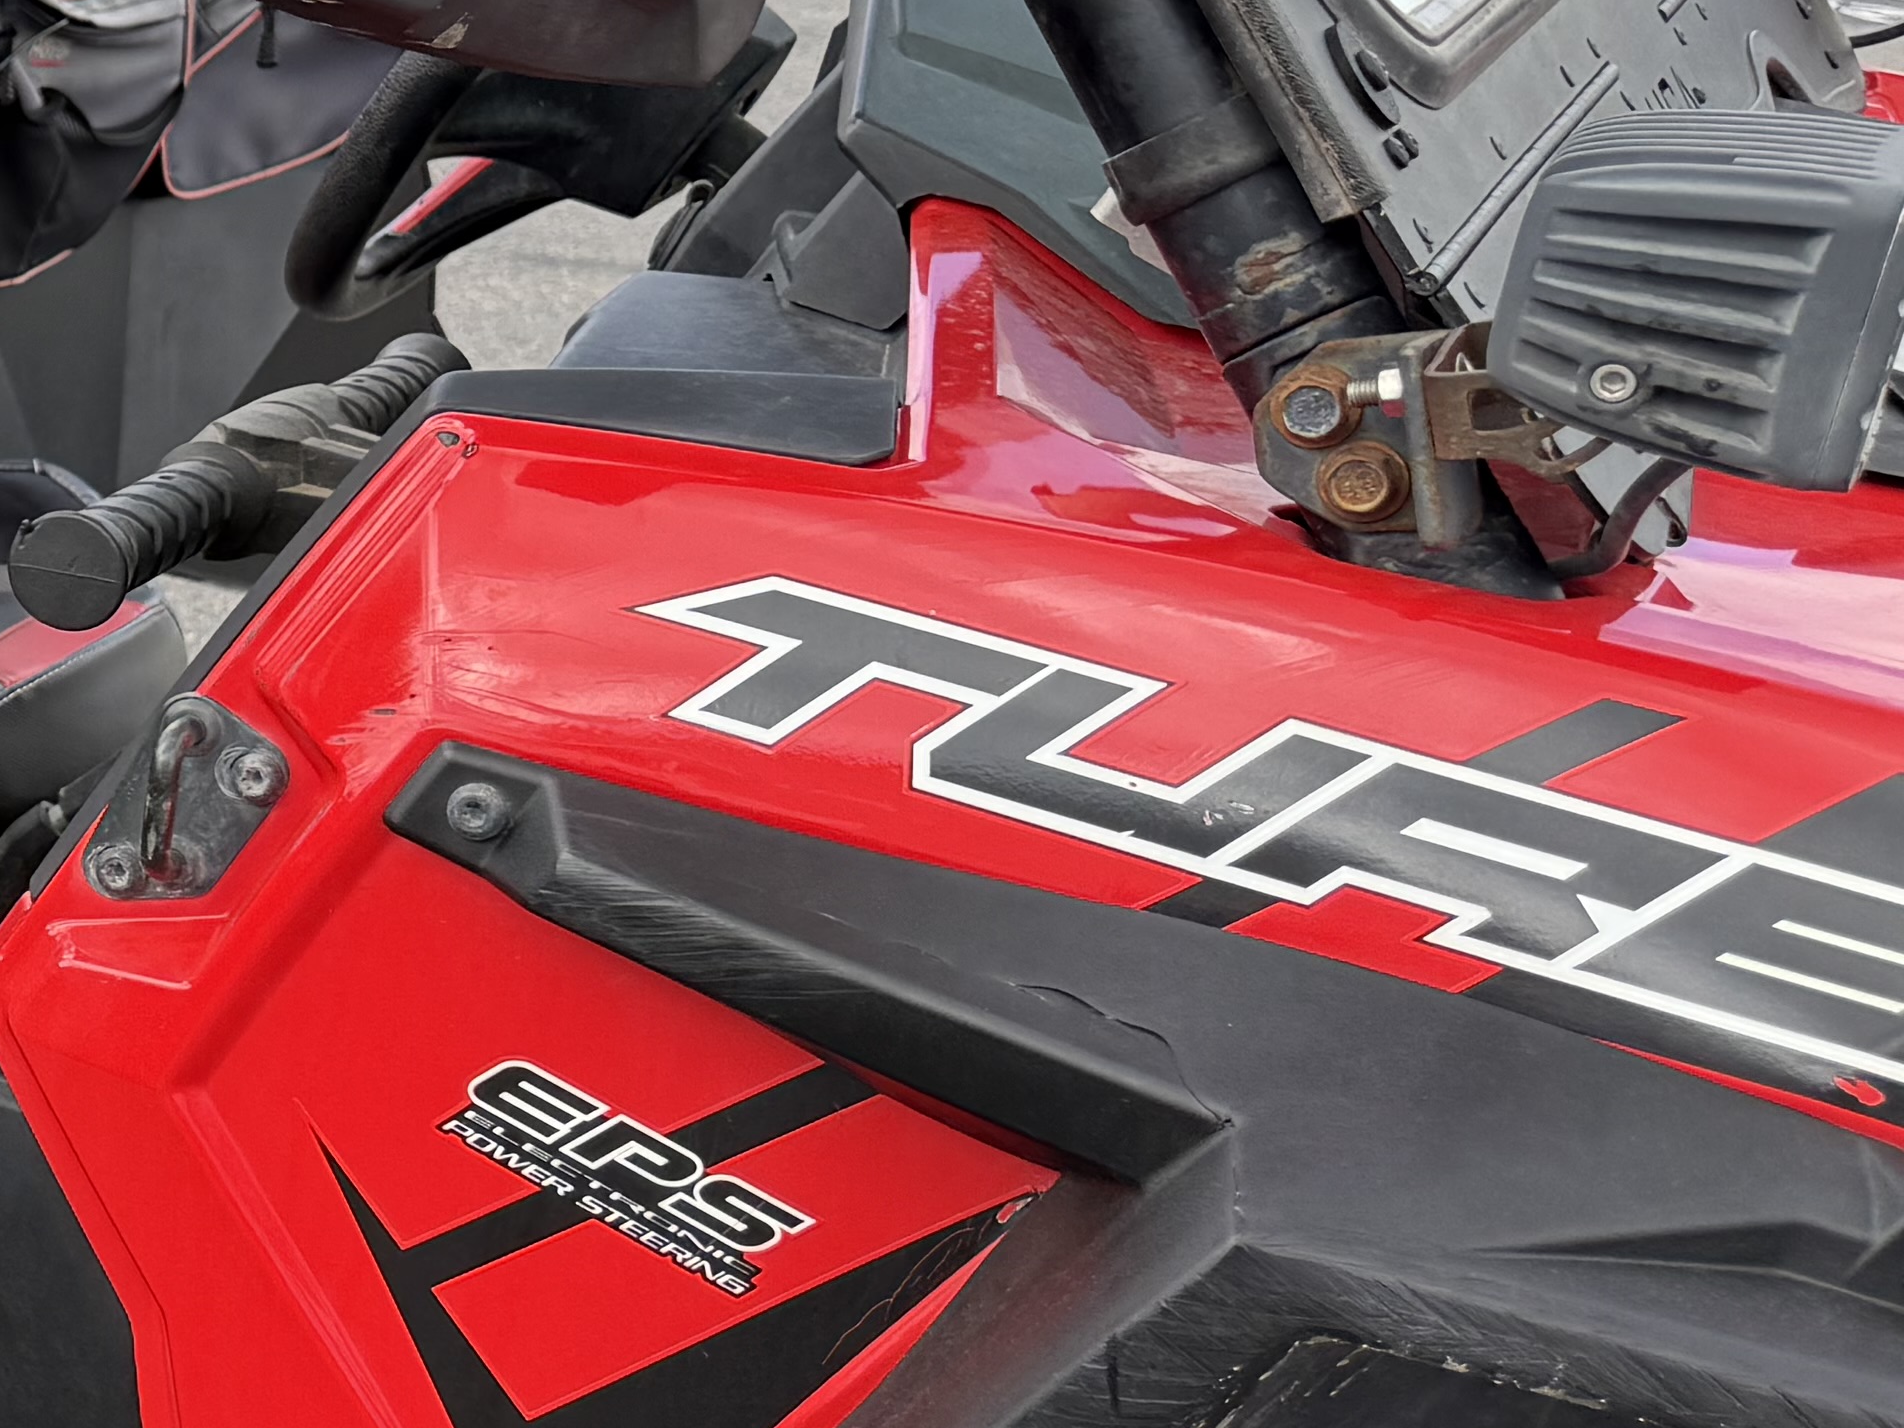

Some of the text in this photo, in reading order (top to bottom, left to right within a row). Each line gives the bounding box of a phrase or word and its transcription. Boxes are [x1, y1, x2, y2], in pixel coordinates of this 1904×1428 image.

[442, 1118, 752, 1296] POWER STEERING
[463, 1109, 757, 1276] ELECTRONIC
[467, 1059, 817, 1253] EPS
